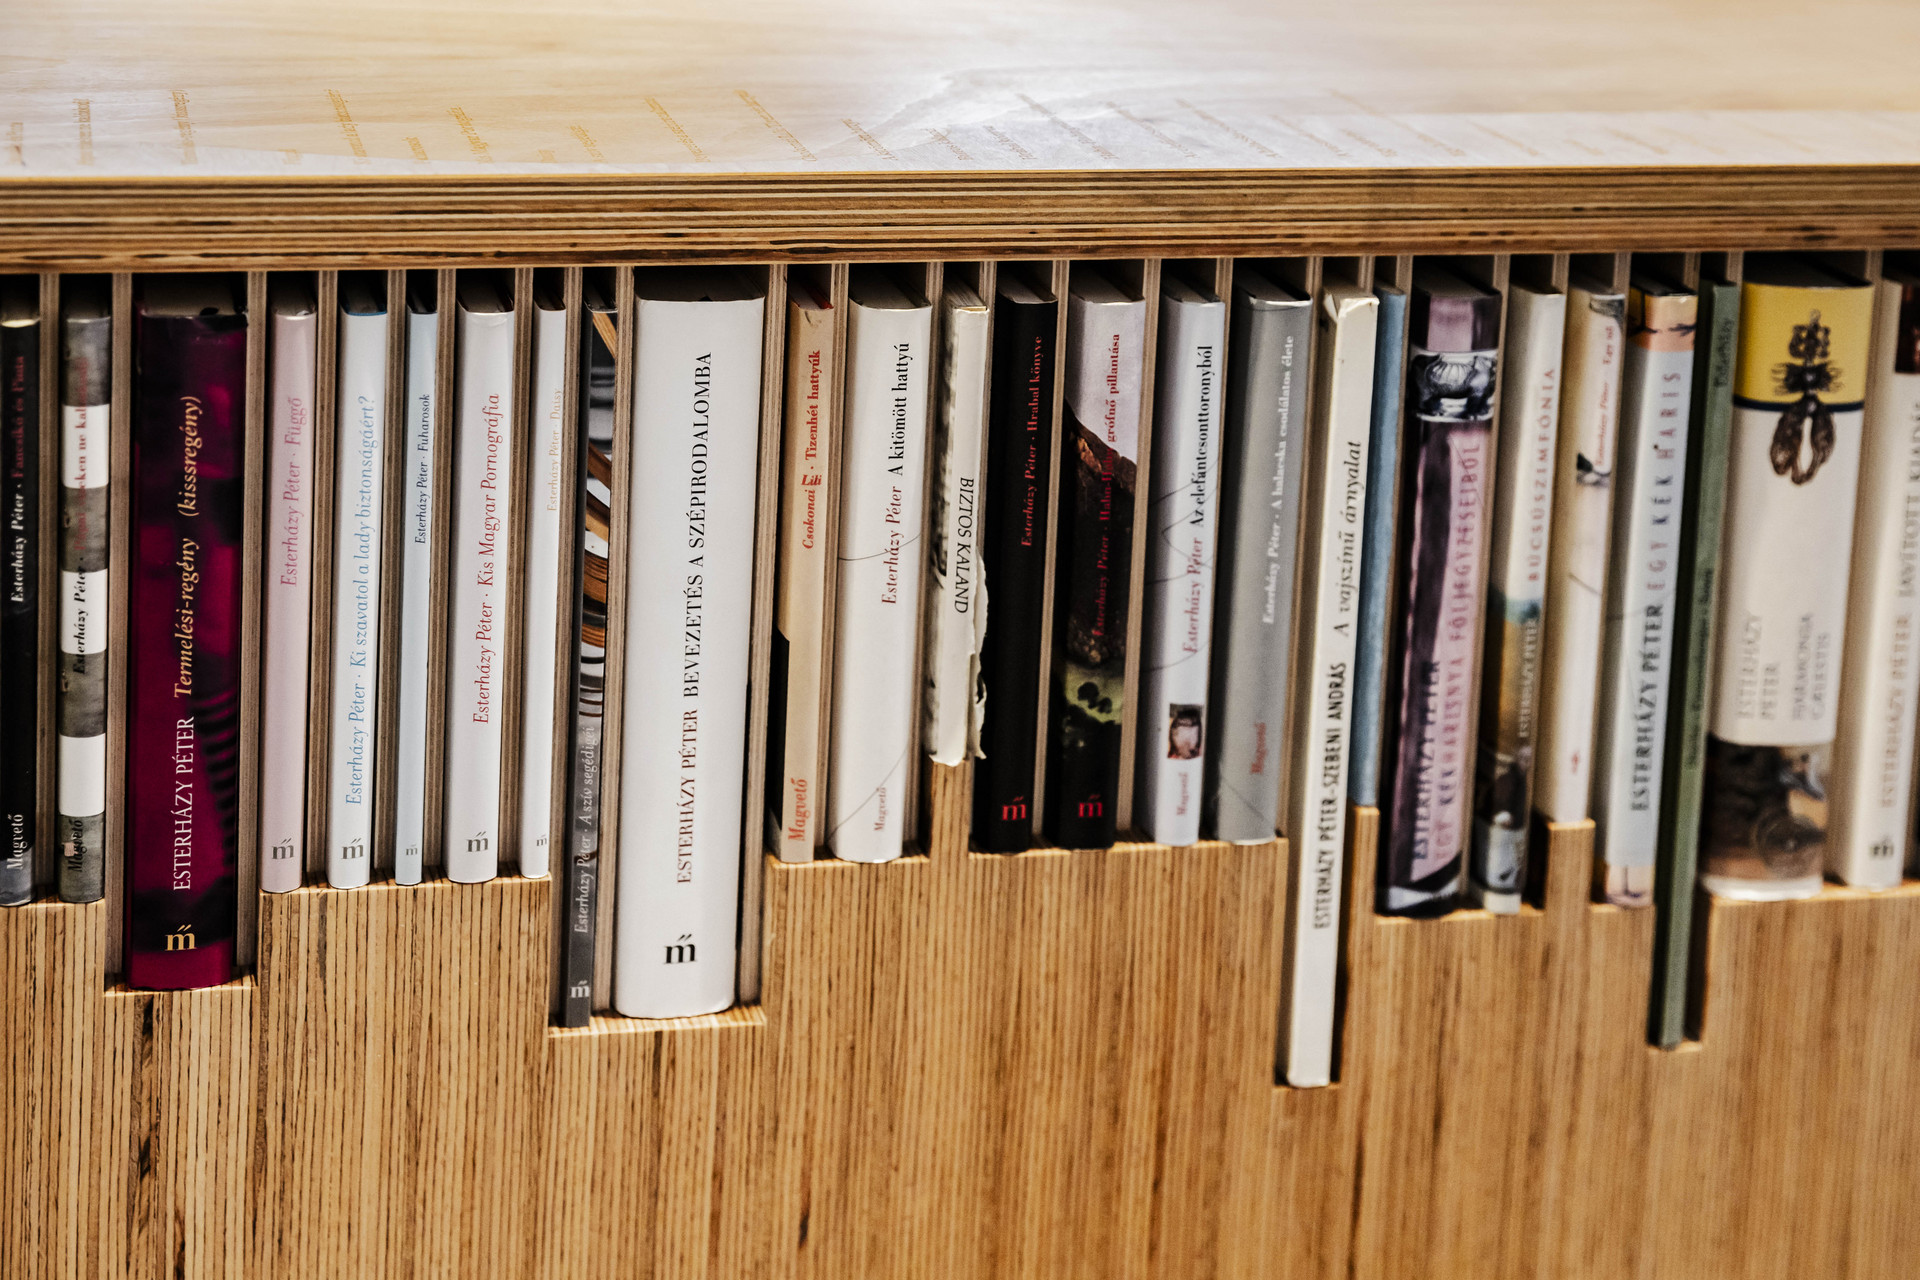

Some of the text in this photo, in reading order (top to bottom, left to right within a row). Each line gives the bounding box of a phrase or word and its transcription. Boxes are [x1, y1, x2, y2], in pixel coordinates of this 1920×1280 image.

[806, 349, 822, 400] hattyúk
[1107, 333, 1121, 395] pillantása
[77, 433, 86, 451] ne
[548, 429, 561, 458] Péter
[805, 404, 819, 461] Tizenhét
[1021, 335, 1043, 547] Esterházy Péter Hrabal könyve
[1104, 399, 1119, 443] grófnő
[1656, 372, 1681, 460] HARIS
[280, 396, 307, 587] Esterházy Péter Függő
[414, 393, 431, 545] Esterházy Péter Fuharosok
[546, 458, 562, 512] Esterházy
[881, 342, 913, 605] Esterházy Péter A kitömött hattyú
[1182, 344, 1214, 654] Esterházy Péter Az elefántcsonttoronyból
[1339, 440, 1364, 524] árnyalat
[10, 493, 24, 530] Péter
[802, 489, 815, 550] Csokonai
[11, 536, 28, 603] Esterházy
[473, 393, 503, 725] Esterházy Péter Kis Magyar Pornográfia
[953, 477, 975, 614] BIZTOS KALAND
[1337, 531, 1358, 613] vajszínű
[1646, 541, 1667, 591] EGY
[73, 565, 87, 603] Péter
[345, 395, 378, 805] Esterházy Péter Ki szavatol a lady biztonságáért?
[72, 609, 88, 675] Esterházy
[171, 395, 203, 891] ESTERHÁZY PÉTER Termelési-regény (kisssregény)
[676, 352, 712, 884] ESTERHÁZY PÉTER BEVEZETÉS A SZÉPIRODALOMBA
[1333, 623, 1349, 637] A
[1636, 605, 1664, 673] PÉTER
[1326, 662, 1346, 721] ANDRÁS
[1630, 680, 1657, 811] ESTERHÁZY
[7, 814, 25, 870] Magvető
[575, 726, 597, 934] Esterházy Péter A szív segédigéi
[788, 777, 810, 842] Magvető
[68, 820, 87, 873] Magvető
[1313, 850, 1335, 929] ESTERHÁZY
